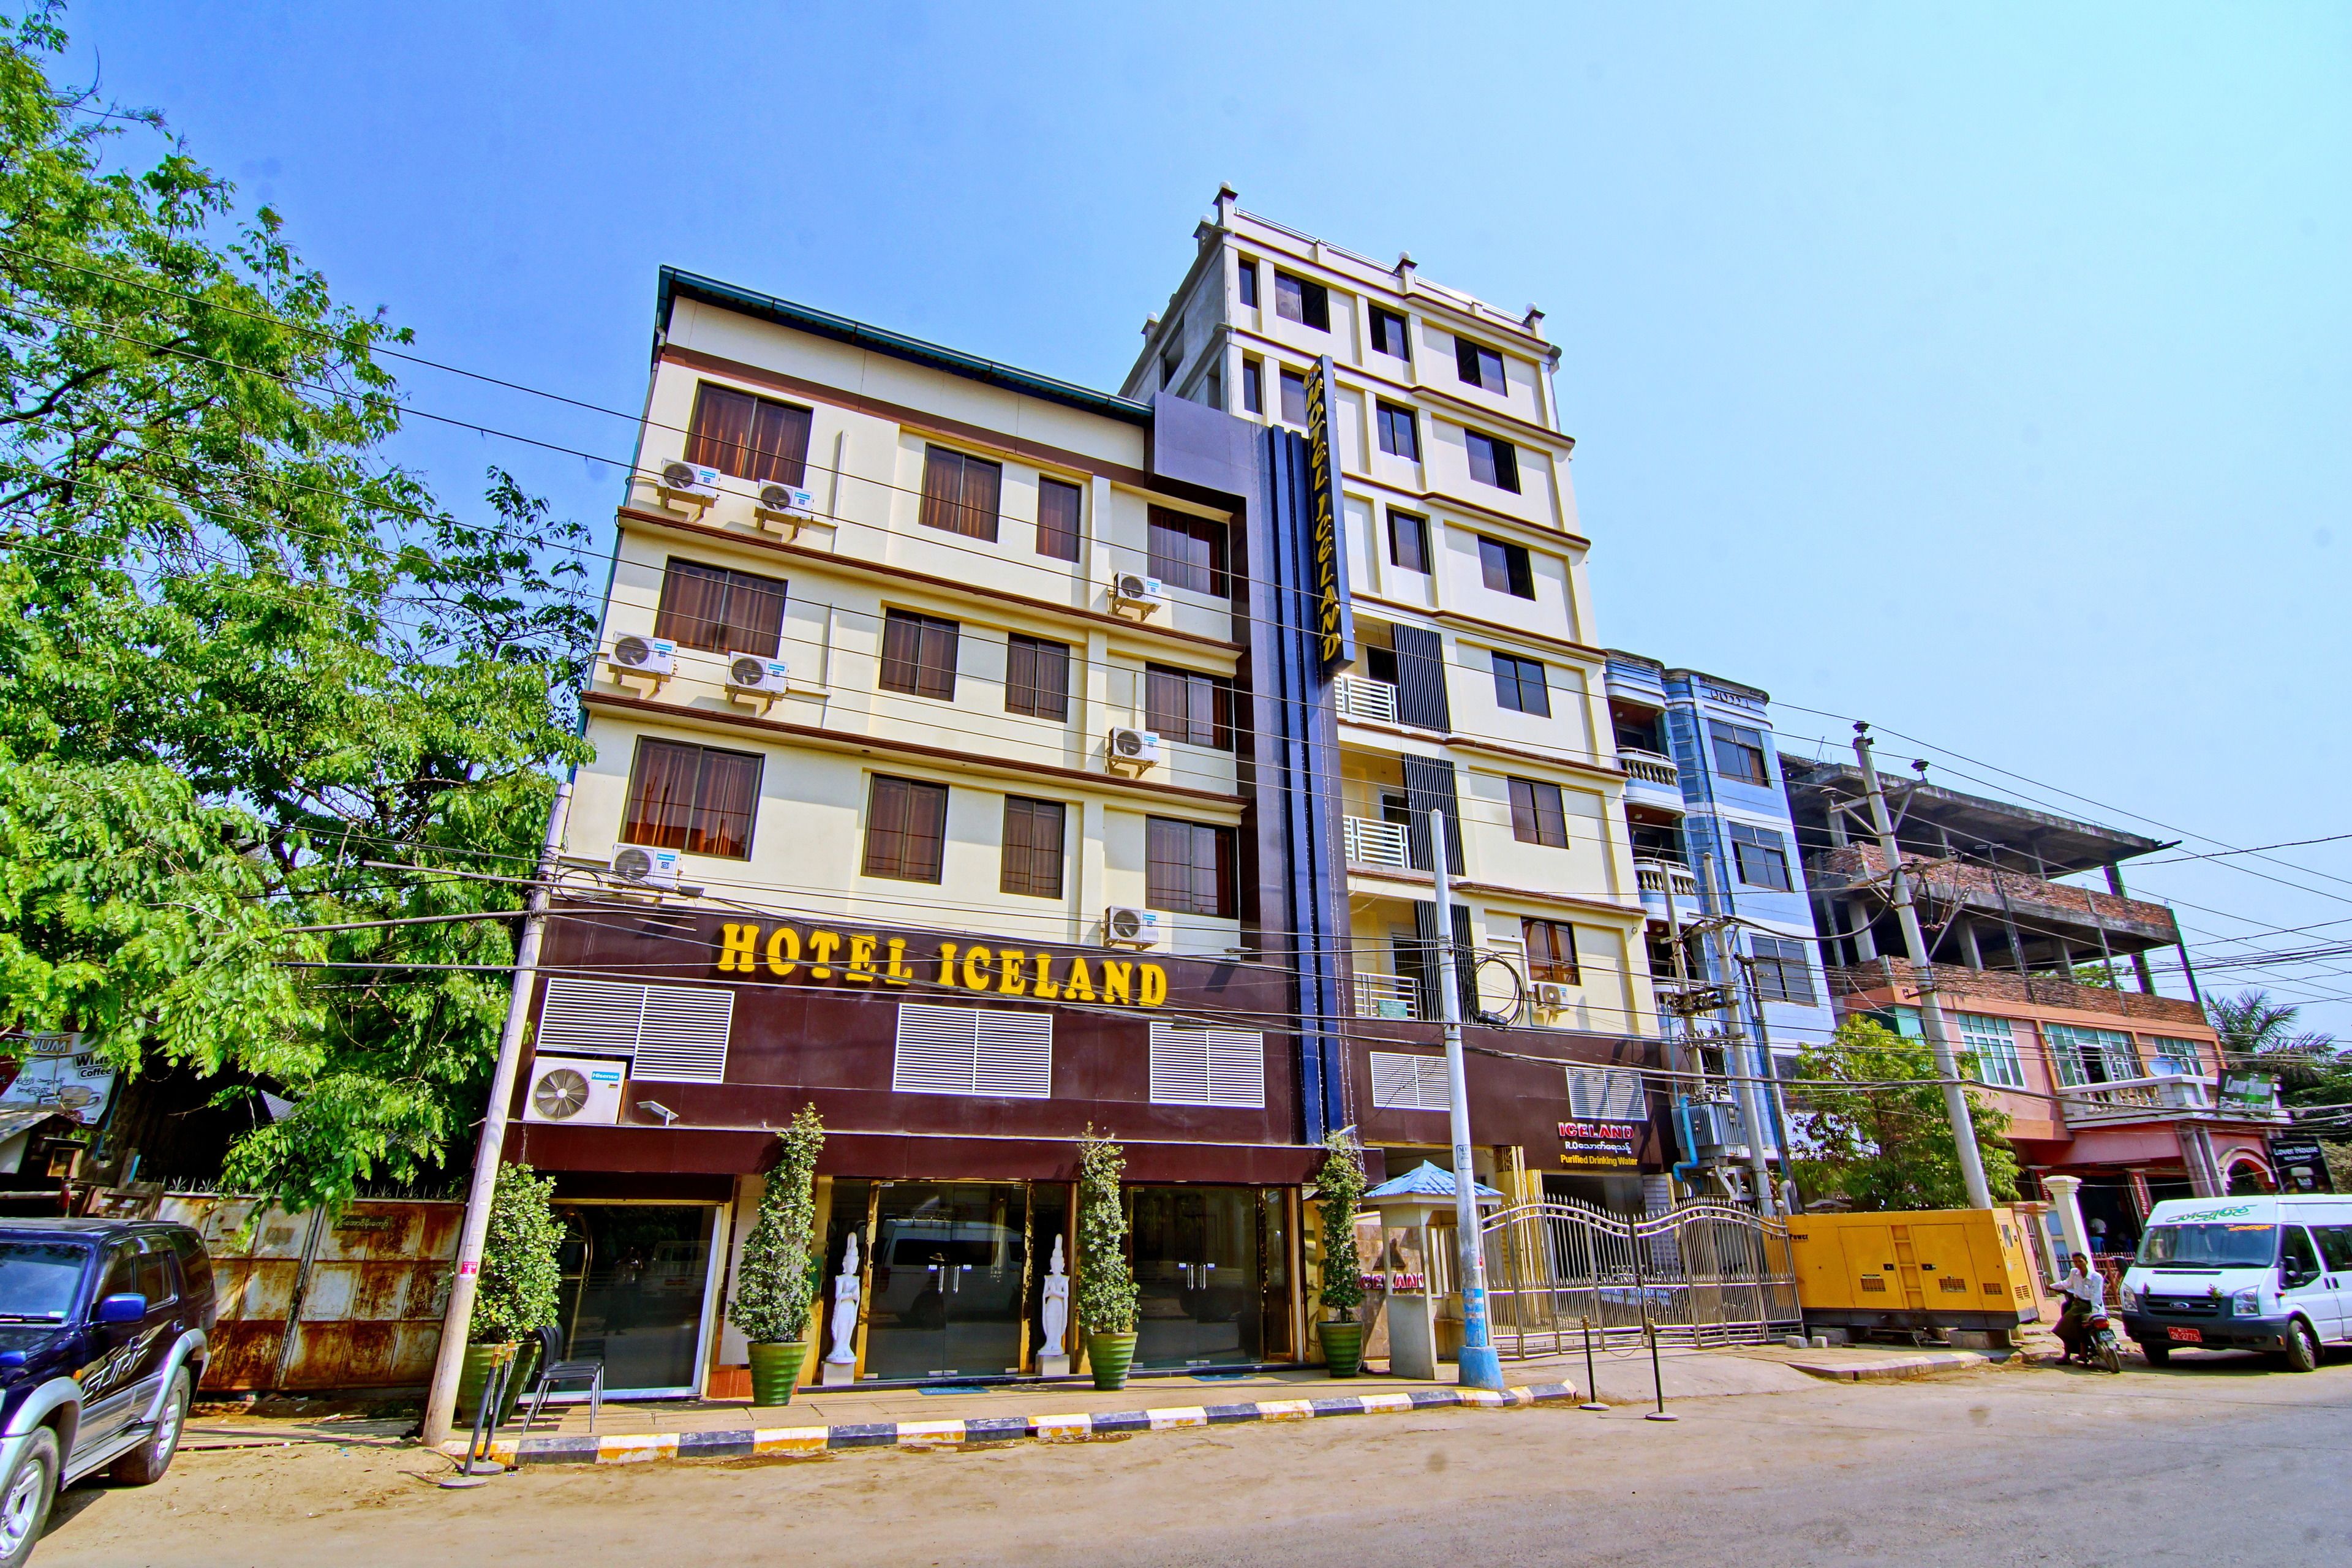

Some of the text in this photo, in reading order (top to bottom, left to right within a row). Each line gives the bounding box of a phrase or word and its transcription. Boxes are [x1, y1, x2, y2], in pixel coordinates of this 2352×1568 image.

[1306, 378, 1341, 662] HOTEL ICELAND
[718, 922, 1167, 1008] HOTEL ICELAND
[80, 1068, 113, 1078] Coffee
[1558, 1122, 1634, 1139] ICELAND
[1560, 1154, 1638, 1167] Purified Drinking Water
[2134, 1176, 2149, 1215] Myanmar
